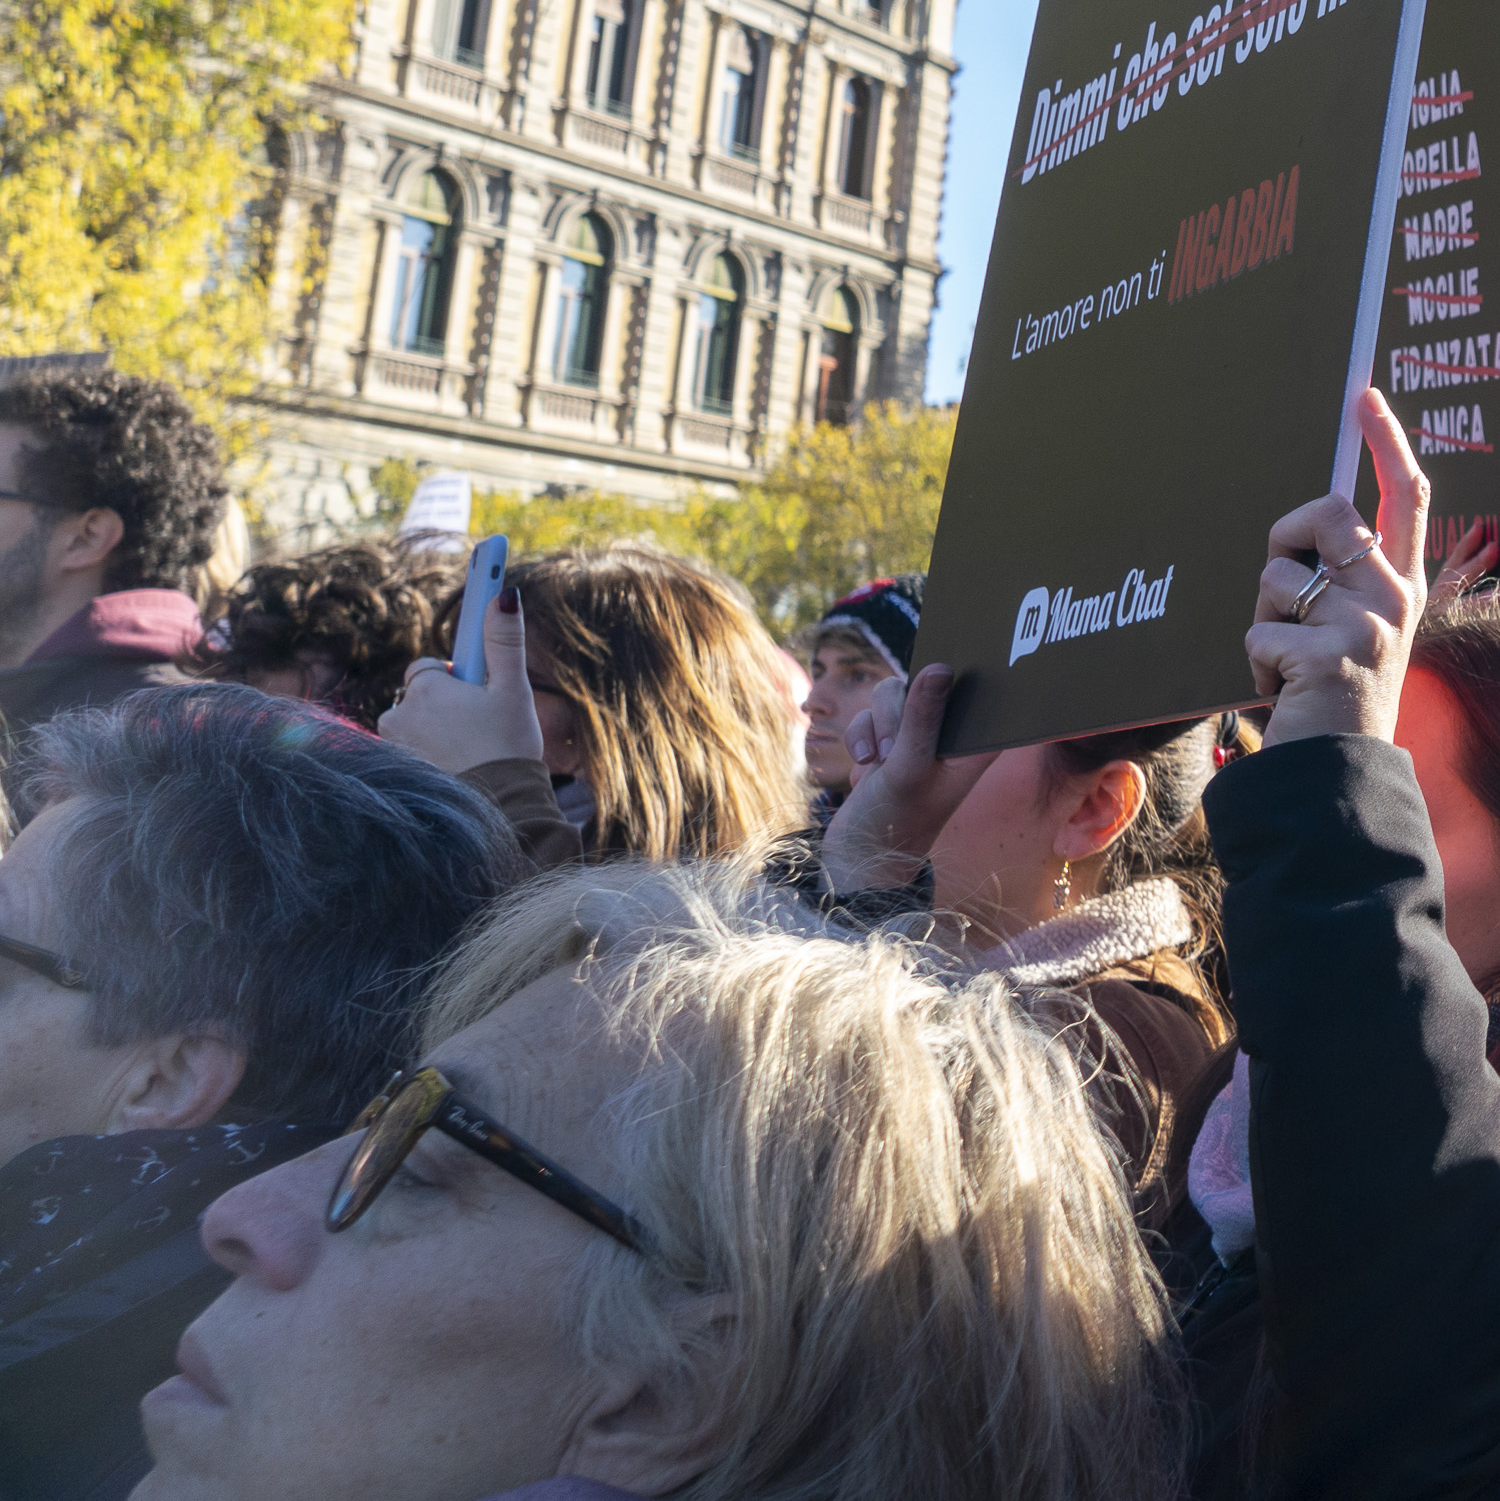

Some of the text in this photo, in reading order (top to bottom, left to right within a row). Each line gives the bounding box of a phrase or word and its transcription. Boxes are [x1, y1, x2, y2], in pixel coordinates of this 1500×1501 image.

[1021, 42, 1122, 186] Dimmi
[1116, 20, 1177, 132] che
[1411, 69, 1464, 129] IGLIA
[1397, 131, 1482, 200] ORELLA
[1011, 164, 1300, 361] L'amore non ti INGABBIA
[1403, 199, 1477, 263] MADRE
[1407, 266, 1481, 327] MOGLIE
[1419, 403, 1486, 456] AMICA
[1044, 586, 1116, 644] Mama
[1116, 564, 1175, 628] Chat
